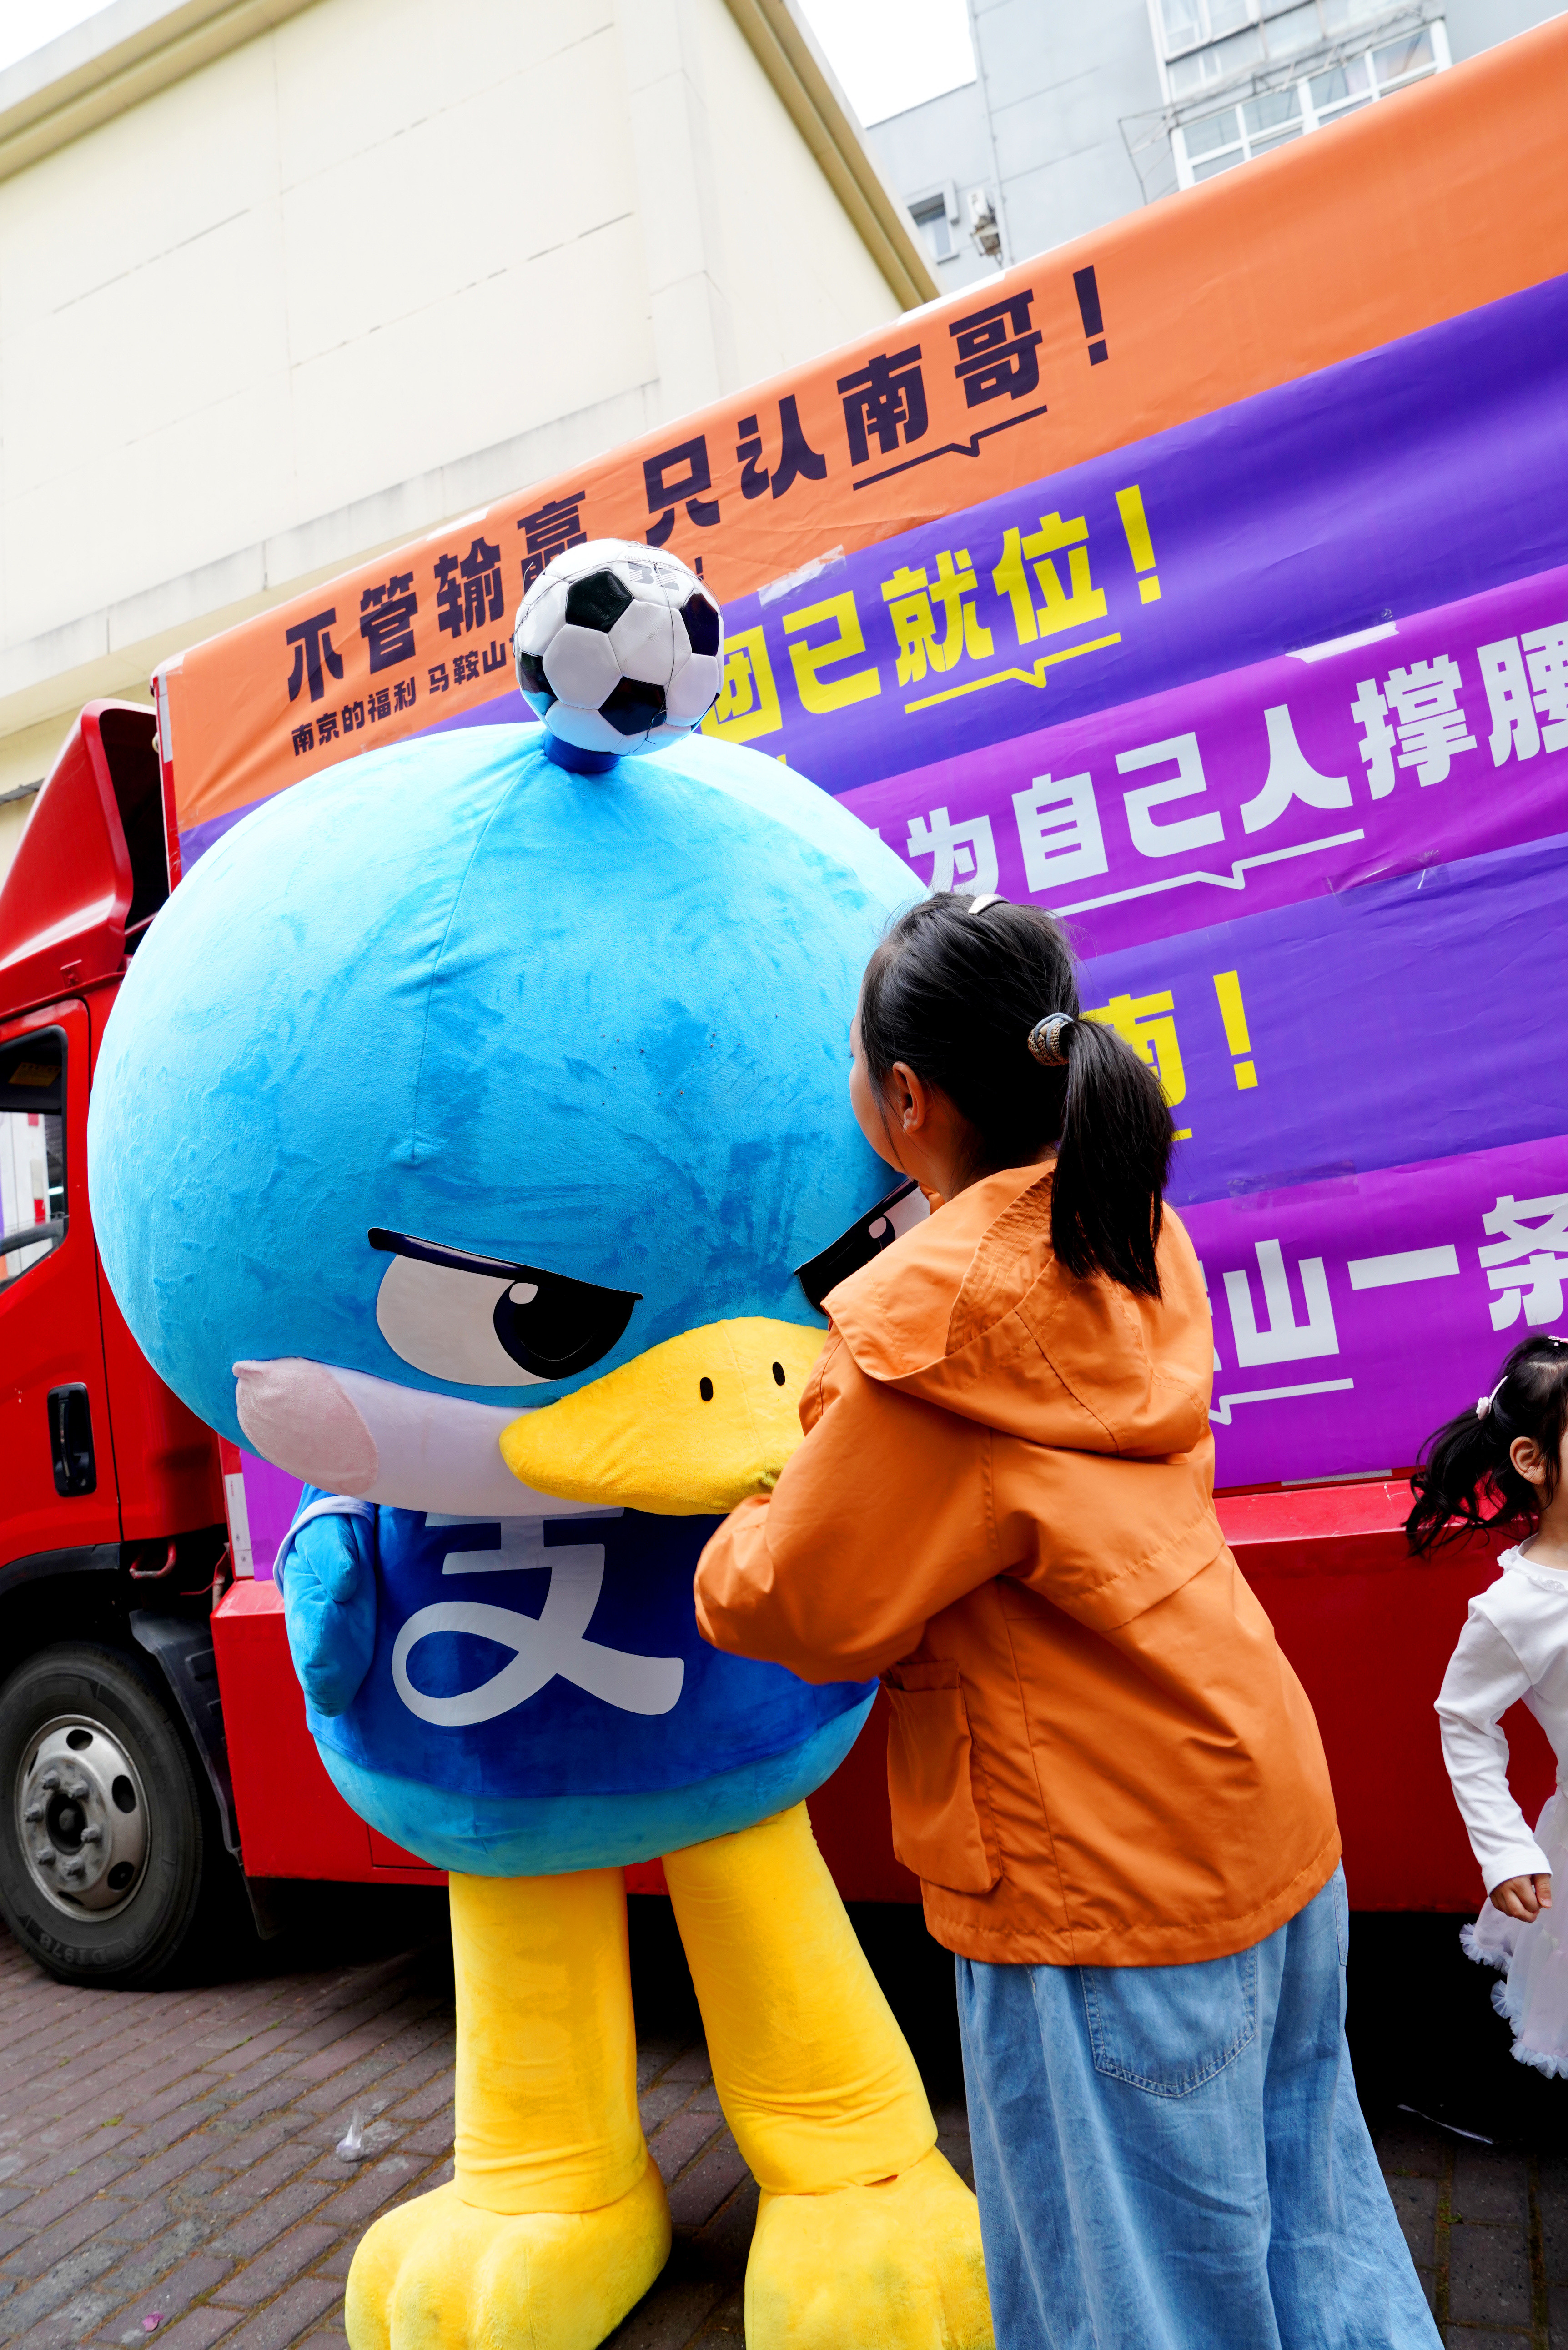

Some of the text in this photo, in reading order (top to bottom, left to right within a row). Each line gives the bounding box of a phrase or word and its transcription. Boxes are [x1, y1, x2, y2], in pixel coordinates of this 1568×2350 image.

[643, 265, 1109, 548] 只认南哥！
[291, 677, 416, 756] 南京的福利
[429, 633, 515, 695] 马鞍山
[871, 621, 1568, 894] 为自己人撑腰
[1198, 1193, 1568, 1371] 山一条
